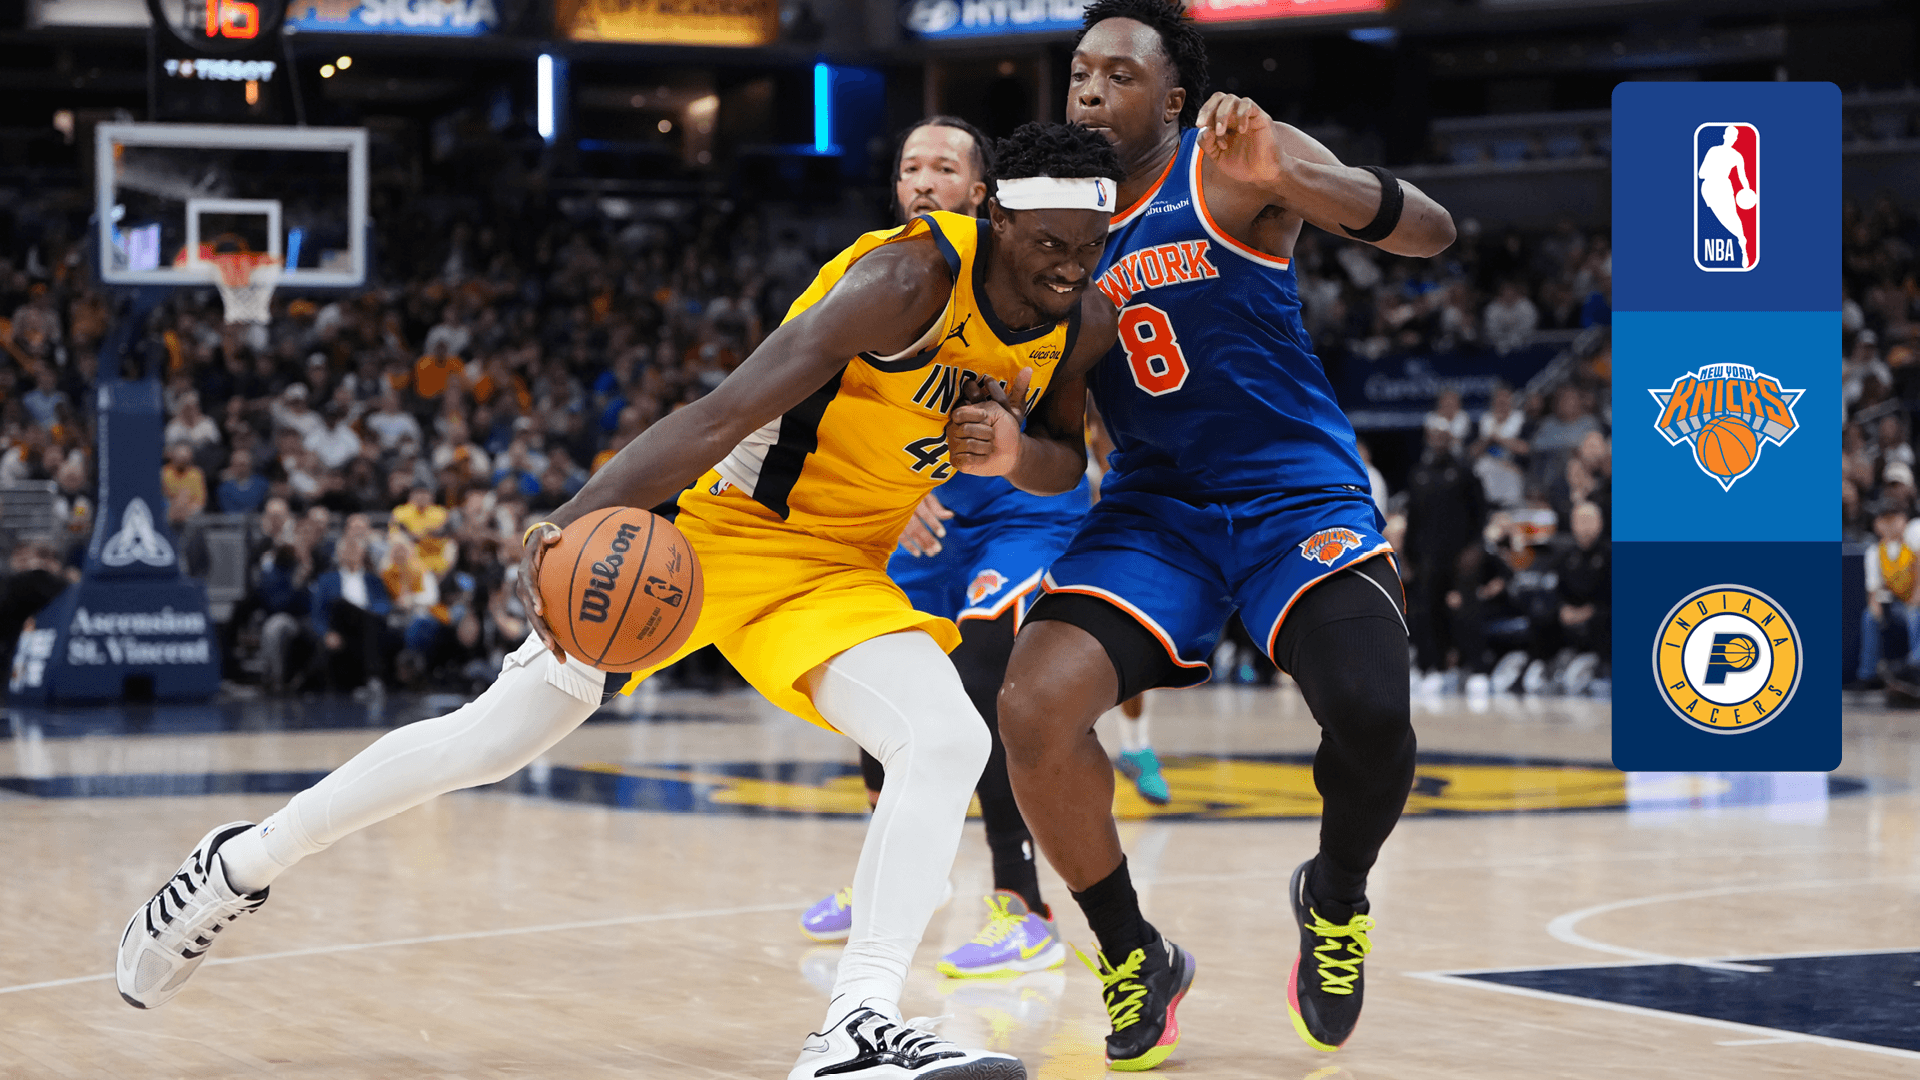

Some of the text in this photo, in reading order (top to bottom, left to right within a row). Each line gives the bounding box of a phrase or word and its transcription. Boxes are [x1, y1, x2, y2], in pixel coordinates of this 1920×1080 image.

[1117, 302, 1190, 397] 8
[578, 522, 642, 624] Wilson
[70, 606, 206, 636] Ascension
[106, 637, 210, 665] Vincent
